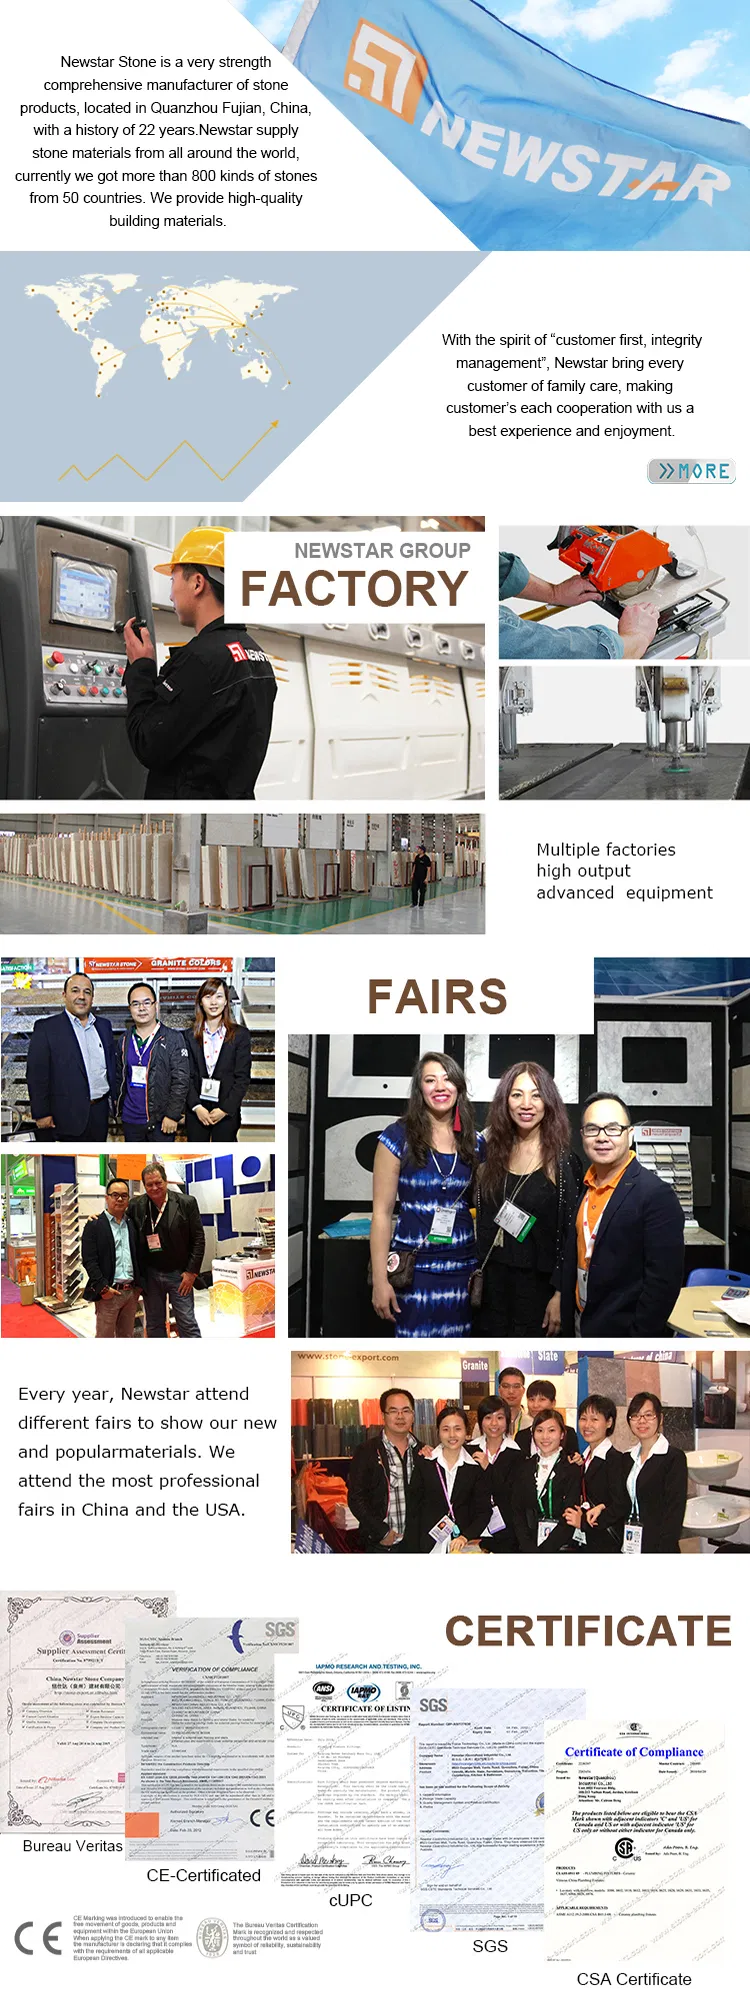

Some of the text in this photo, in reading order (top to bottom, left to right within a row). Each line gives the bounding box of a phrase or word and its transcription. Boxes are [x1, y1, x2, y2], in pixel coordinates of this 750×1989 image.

[422, 101, 731, 206] NEWSTAR
[537, 1350, 559, 1362] Slate
[462, 1360, 488, 1370] Granite
[265, 1621, 296, 1637] SGS
[36, 1648, 70, 1656] Supplier
[382, 1663, 409, 1671] TESTING,
[419, 1698, 448, 1712] SGS
[565, 1746, 704, 1759] Certificate of Compliance
